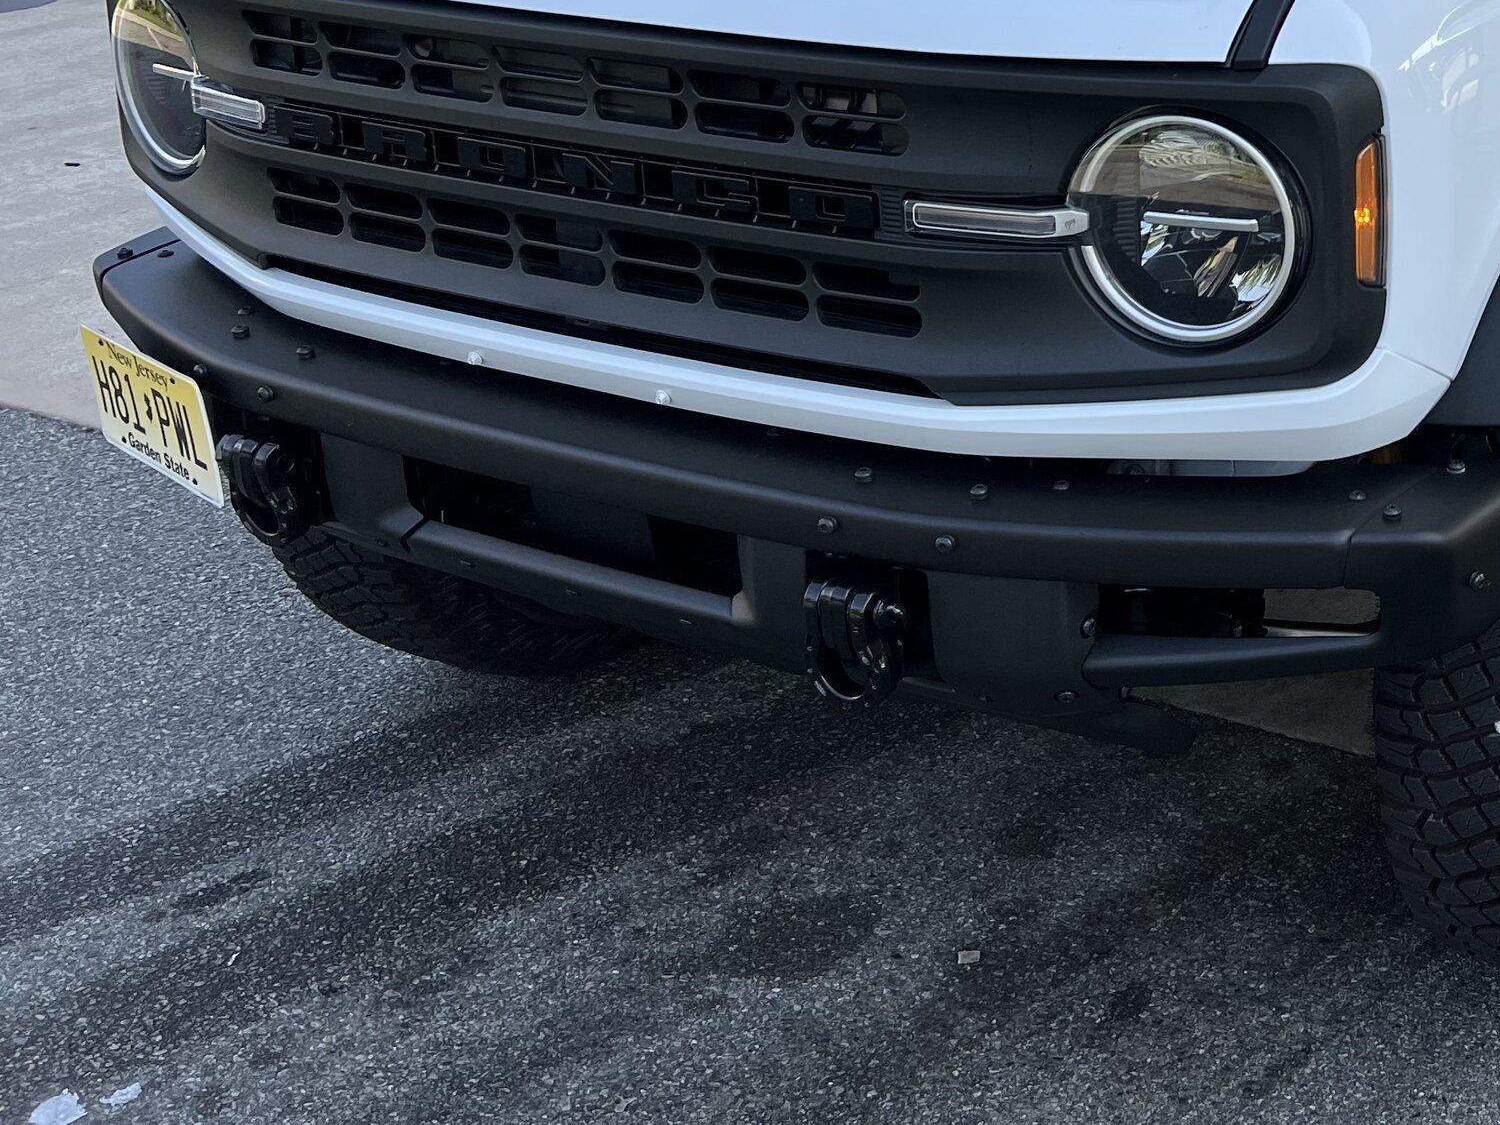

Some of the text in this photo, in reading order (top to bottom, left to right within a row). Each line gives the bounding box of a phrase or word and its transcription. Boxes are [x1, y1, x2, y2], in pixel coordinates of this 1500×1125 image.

[284, 107, 875, 231] BRONCO
[105, 340, 169, 392] New Jersey
[128, 431, 190, 481] Garden State
